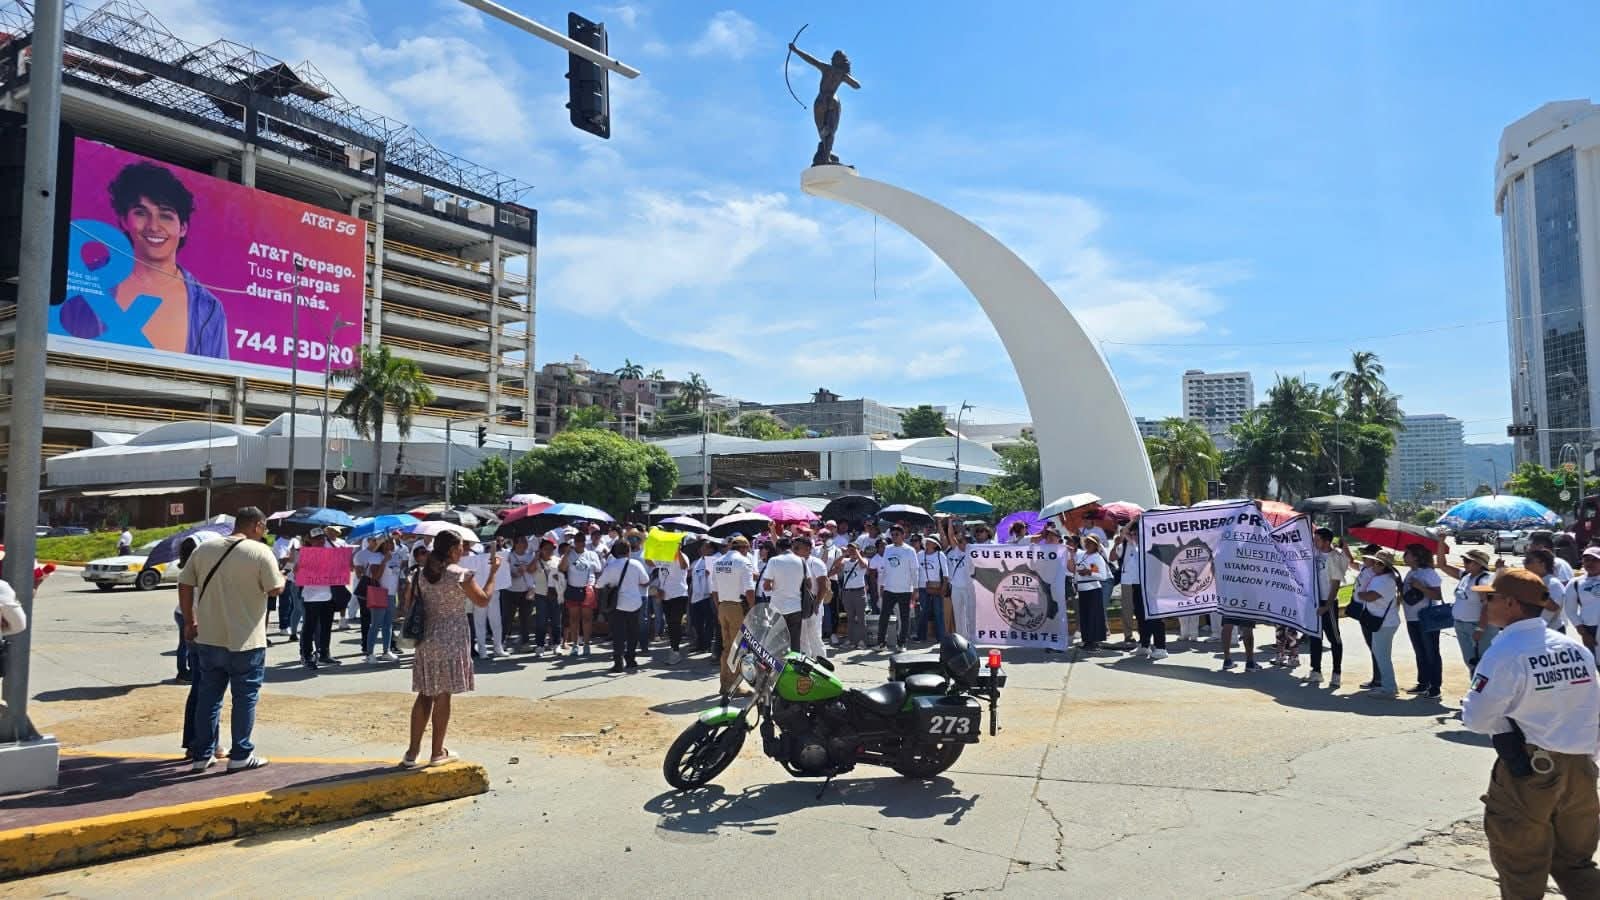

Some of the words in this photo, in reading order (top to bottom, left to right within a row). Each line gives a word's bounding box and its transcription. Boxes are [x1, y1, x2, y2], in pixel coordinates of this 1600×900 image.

[301, 211, 335, 230] AT&T
[335, 221, 357, 236] 5G
[248, 241, 289, 263] AT&T
[292, 252, 356, 278] Prepago.
[247, 261, 273, 279] Tus
[276, 270, 340, 293] recargas
[246, 282, 292, 303] duran
[296, 294, 330, 311] más.
[234, 328, 278, 353] 744
[1151, 516, 1235, 537] ¡GUERRERO
[970, 550, 1057, 560] GUERRERO
[1012, 575, 1033, 587] RJP
[978, 630, 1058, 642] PRESENTE
[762, 651, 777, 669] VIAL
[1528, 647, 1585, 670] POLICÍA
[928, 715, 971, 734] 273
